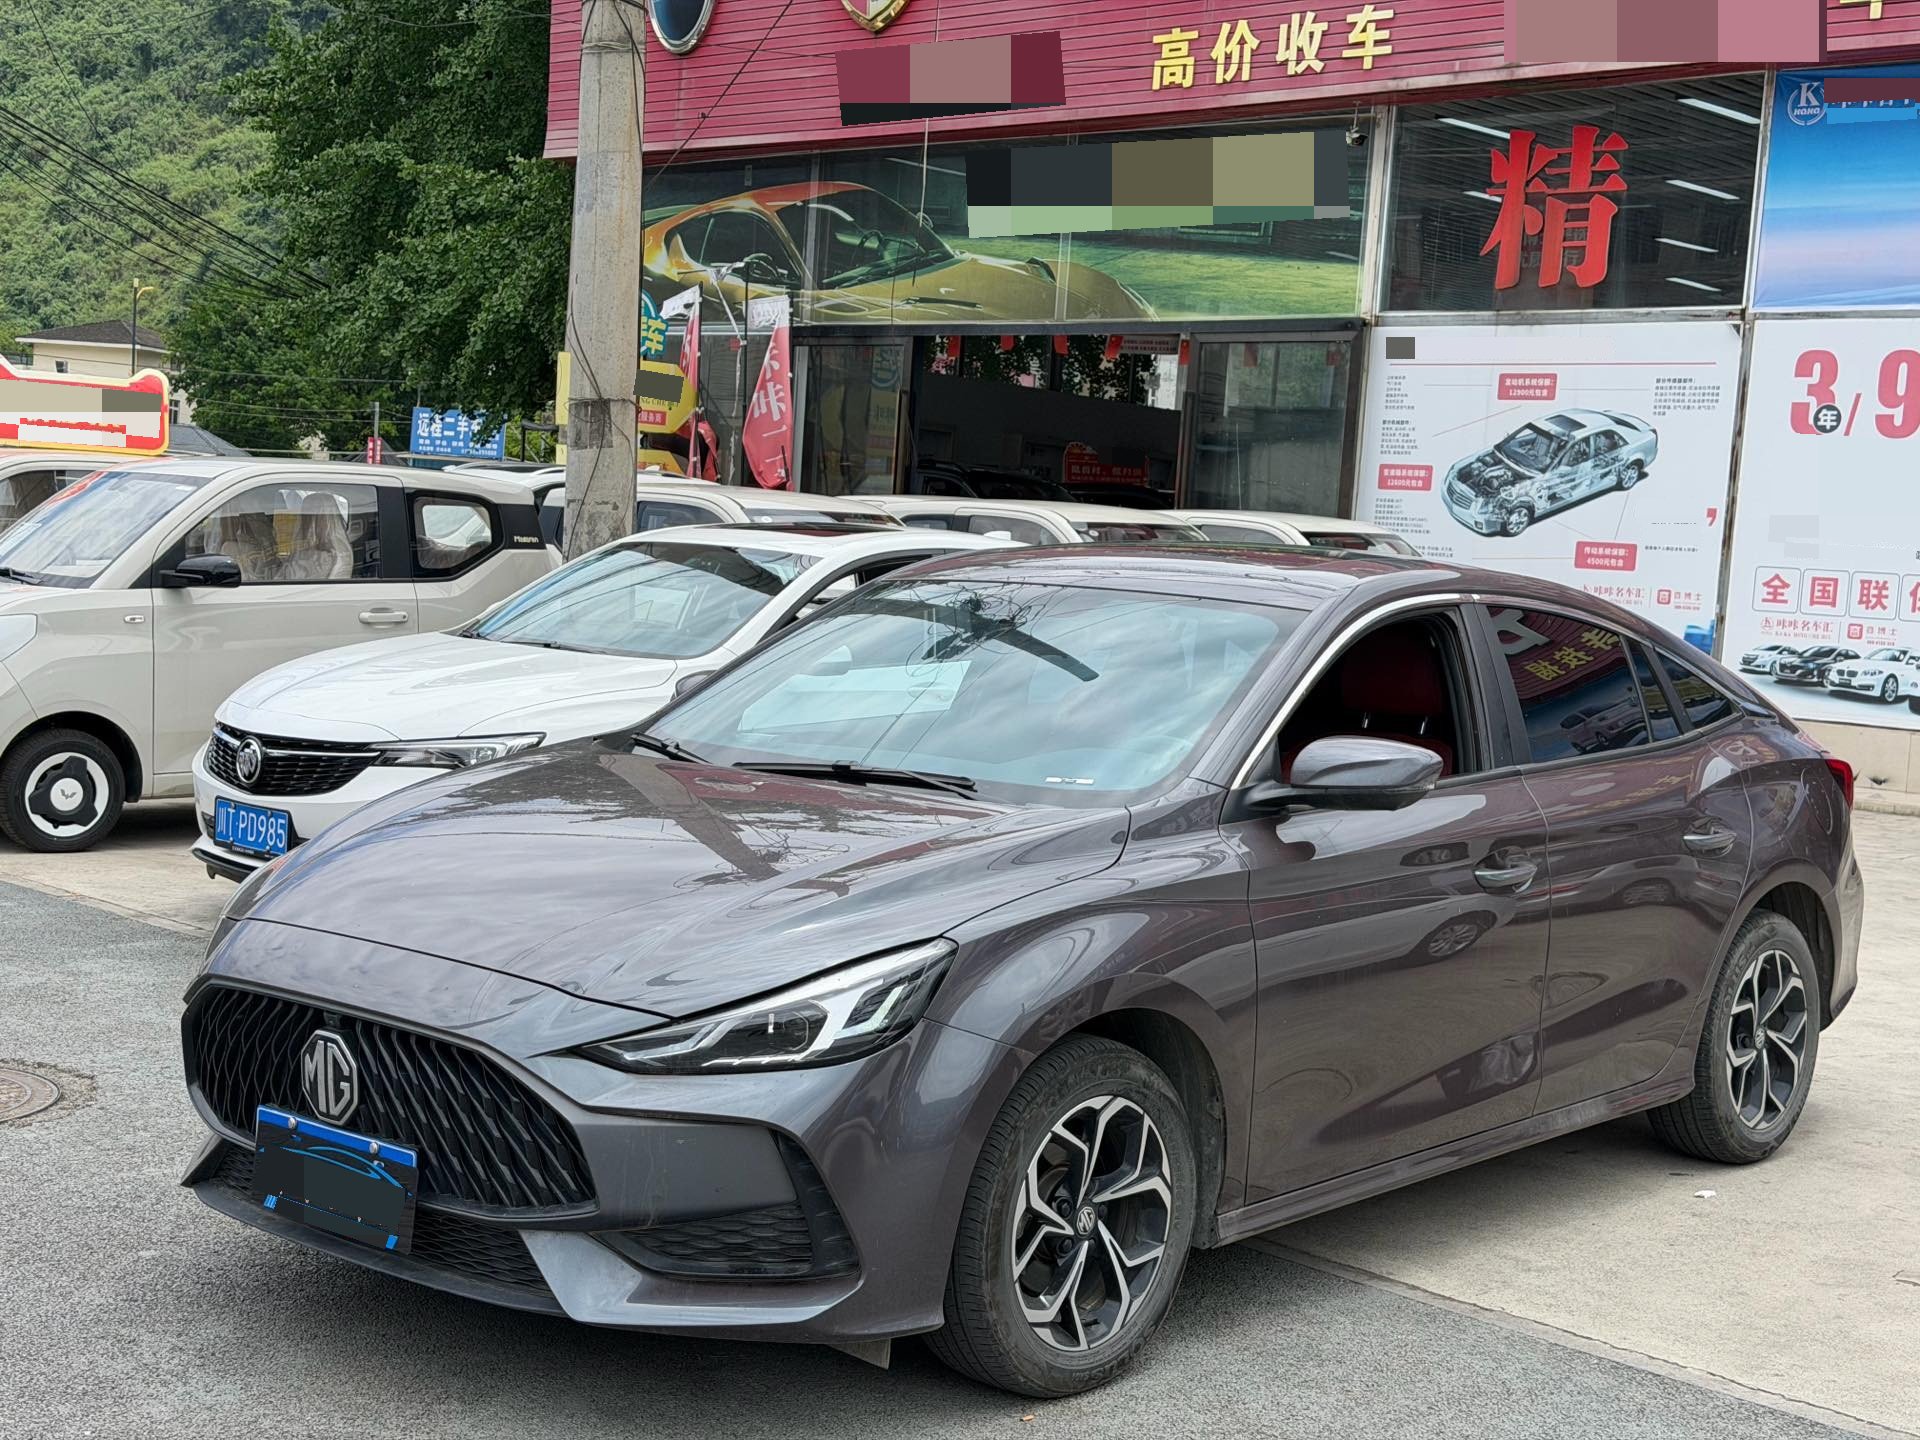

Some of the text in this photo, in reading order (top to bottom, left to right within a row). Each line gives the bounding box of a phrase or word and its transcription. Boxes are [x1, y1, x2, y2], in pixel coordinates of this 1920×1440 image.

[1152, 4, 1394, 90] 高价收车
[1480, 125, 1629, 289] 精
[303, 1036, 353, 1119] MG
